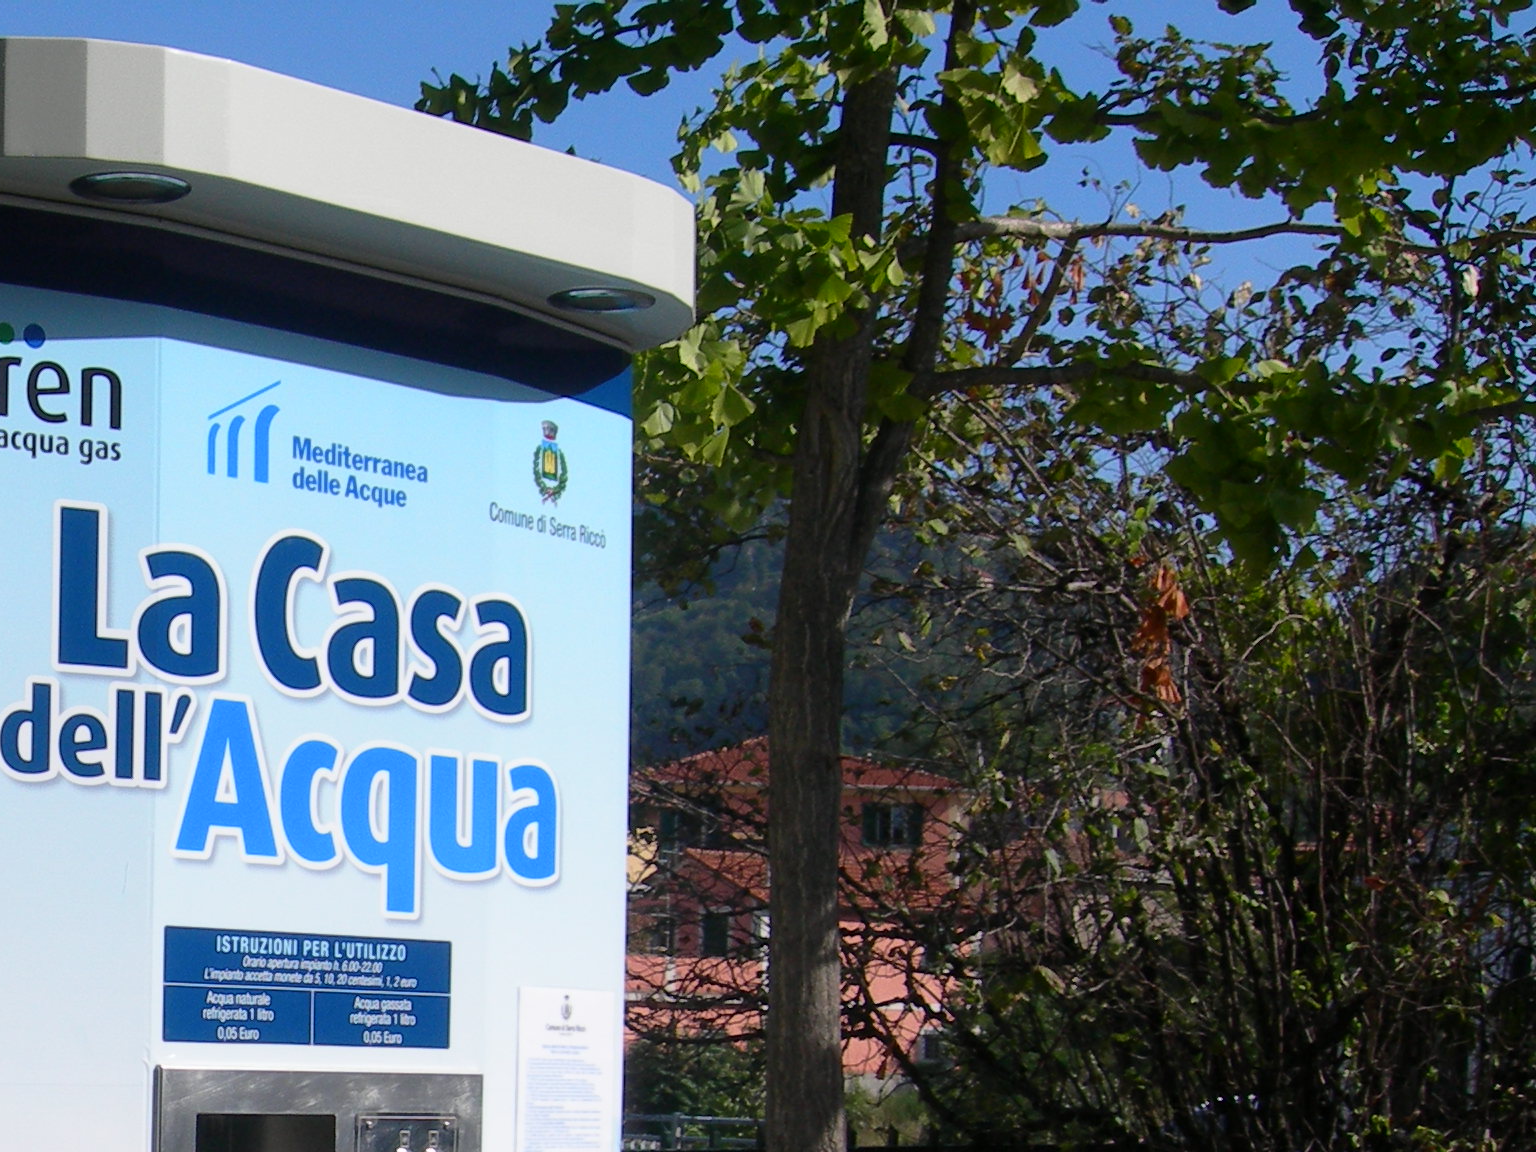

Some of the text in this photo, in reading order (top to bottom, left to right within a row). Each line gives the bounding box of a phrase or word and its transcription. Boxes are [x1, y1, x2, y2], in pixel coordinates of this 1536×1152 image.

[78, 438, 122, 465] gas
[292, 435, 429, 483] Mediterranea
[292, 466, 407, 508] delle Acque
[489, 501, 534, 531] Comune
[536, 514, 547, 534] di
[549, 516, 577, 541] Serra
[57, 505, 528, 717] La Casa
[216, 935, 407, 962] ISTRUZIONI PER L'UTILIZZO
[267, 958, 300, 971] apertura
[300, 959, 332, 973] impianto
[336, 973, 348, 985] 20
[206, 990, 271, 1006] Acqua naturale
[353, 996, 380, 1012] Acqua
[202, 1006, 275, 1023] refrigerata 1 litro
[349, 1011, 392, 1027] refrigerata
[392, 1013, 398, 1026] 1
[217, 1026, 260, 1041] 0,05 Euro
[363, 1030, 403, 1045] 0,05 Euro
